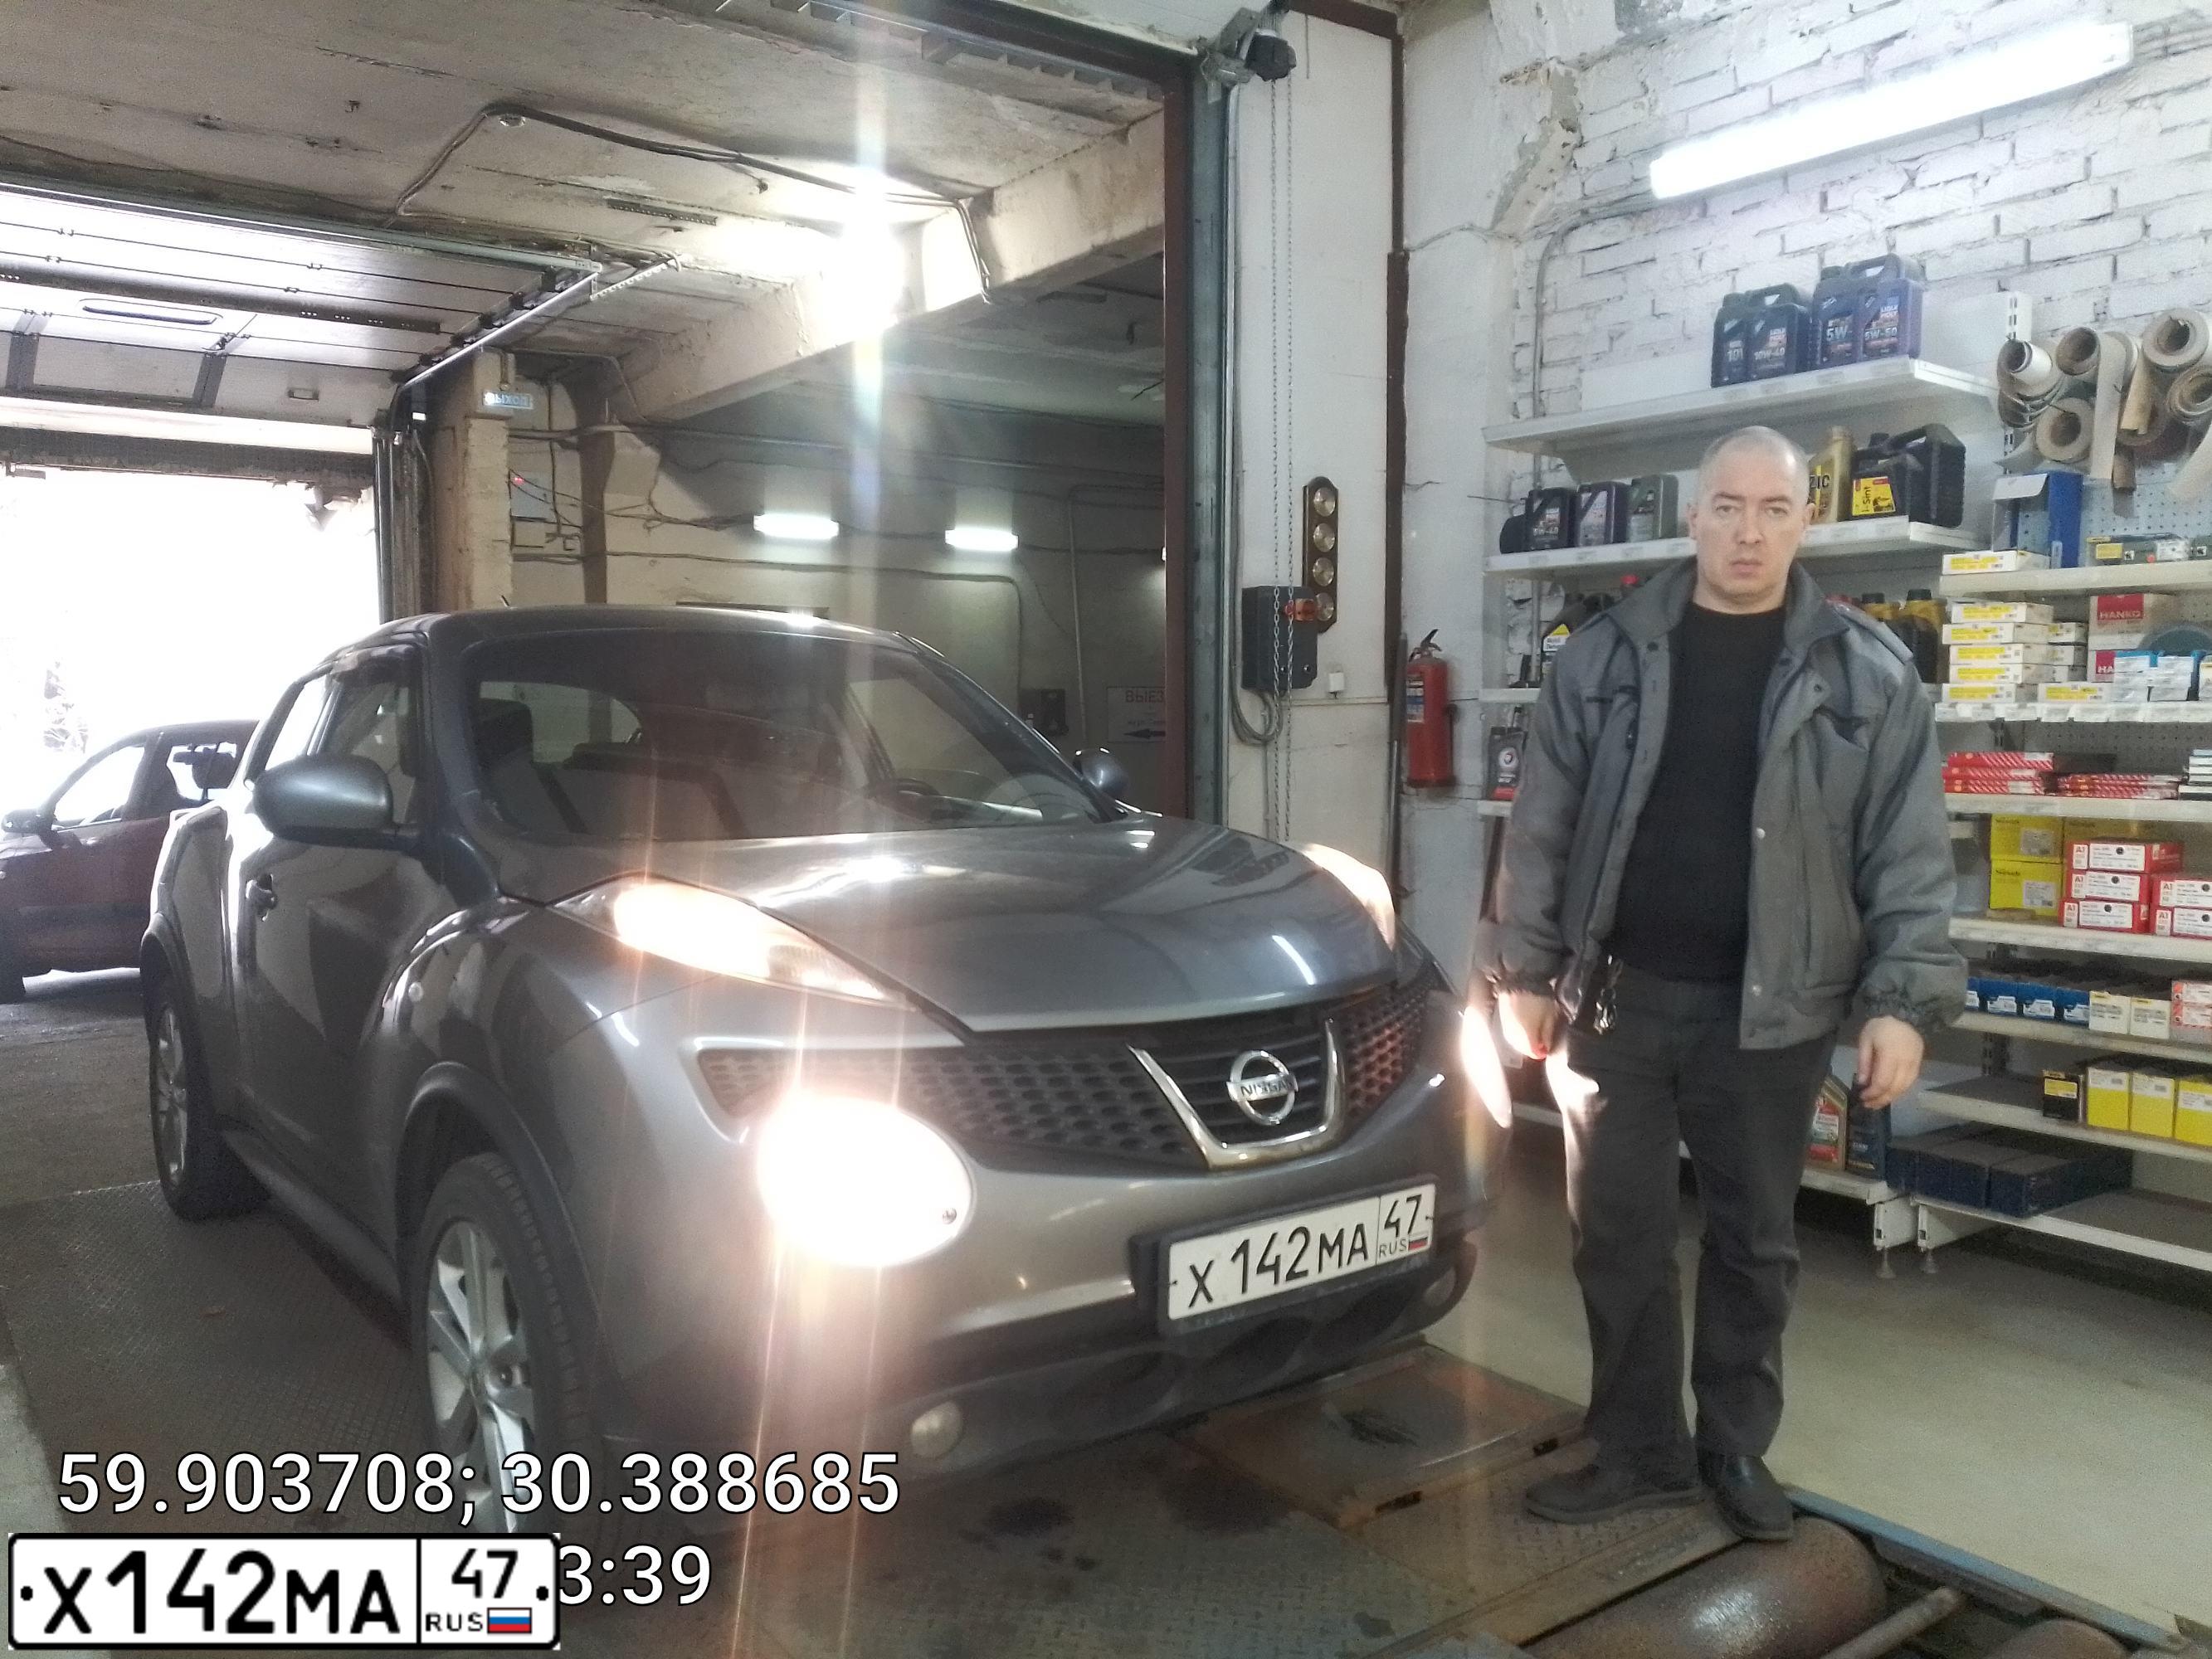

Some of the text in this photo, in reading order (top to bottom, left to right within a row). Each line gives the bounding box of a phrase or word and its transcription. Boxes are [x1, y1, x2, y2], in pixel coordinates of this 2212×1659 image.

[1125, 690, 1164, 703] ВЫЕЗ
[1384, 1194, 1422, 1238] 47
[1379, 1238, 1407, 1258] RUS
